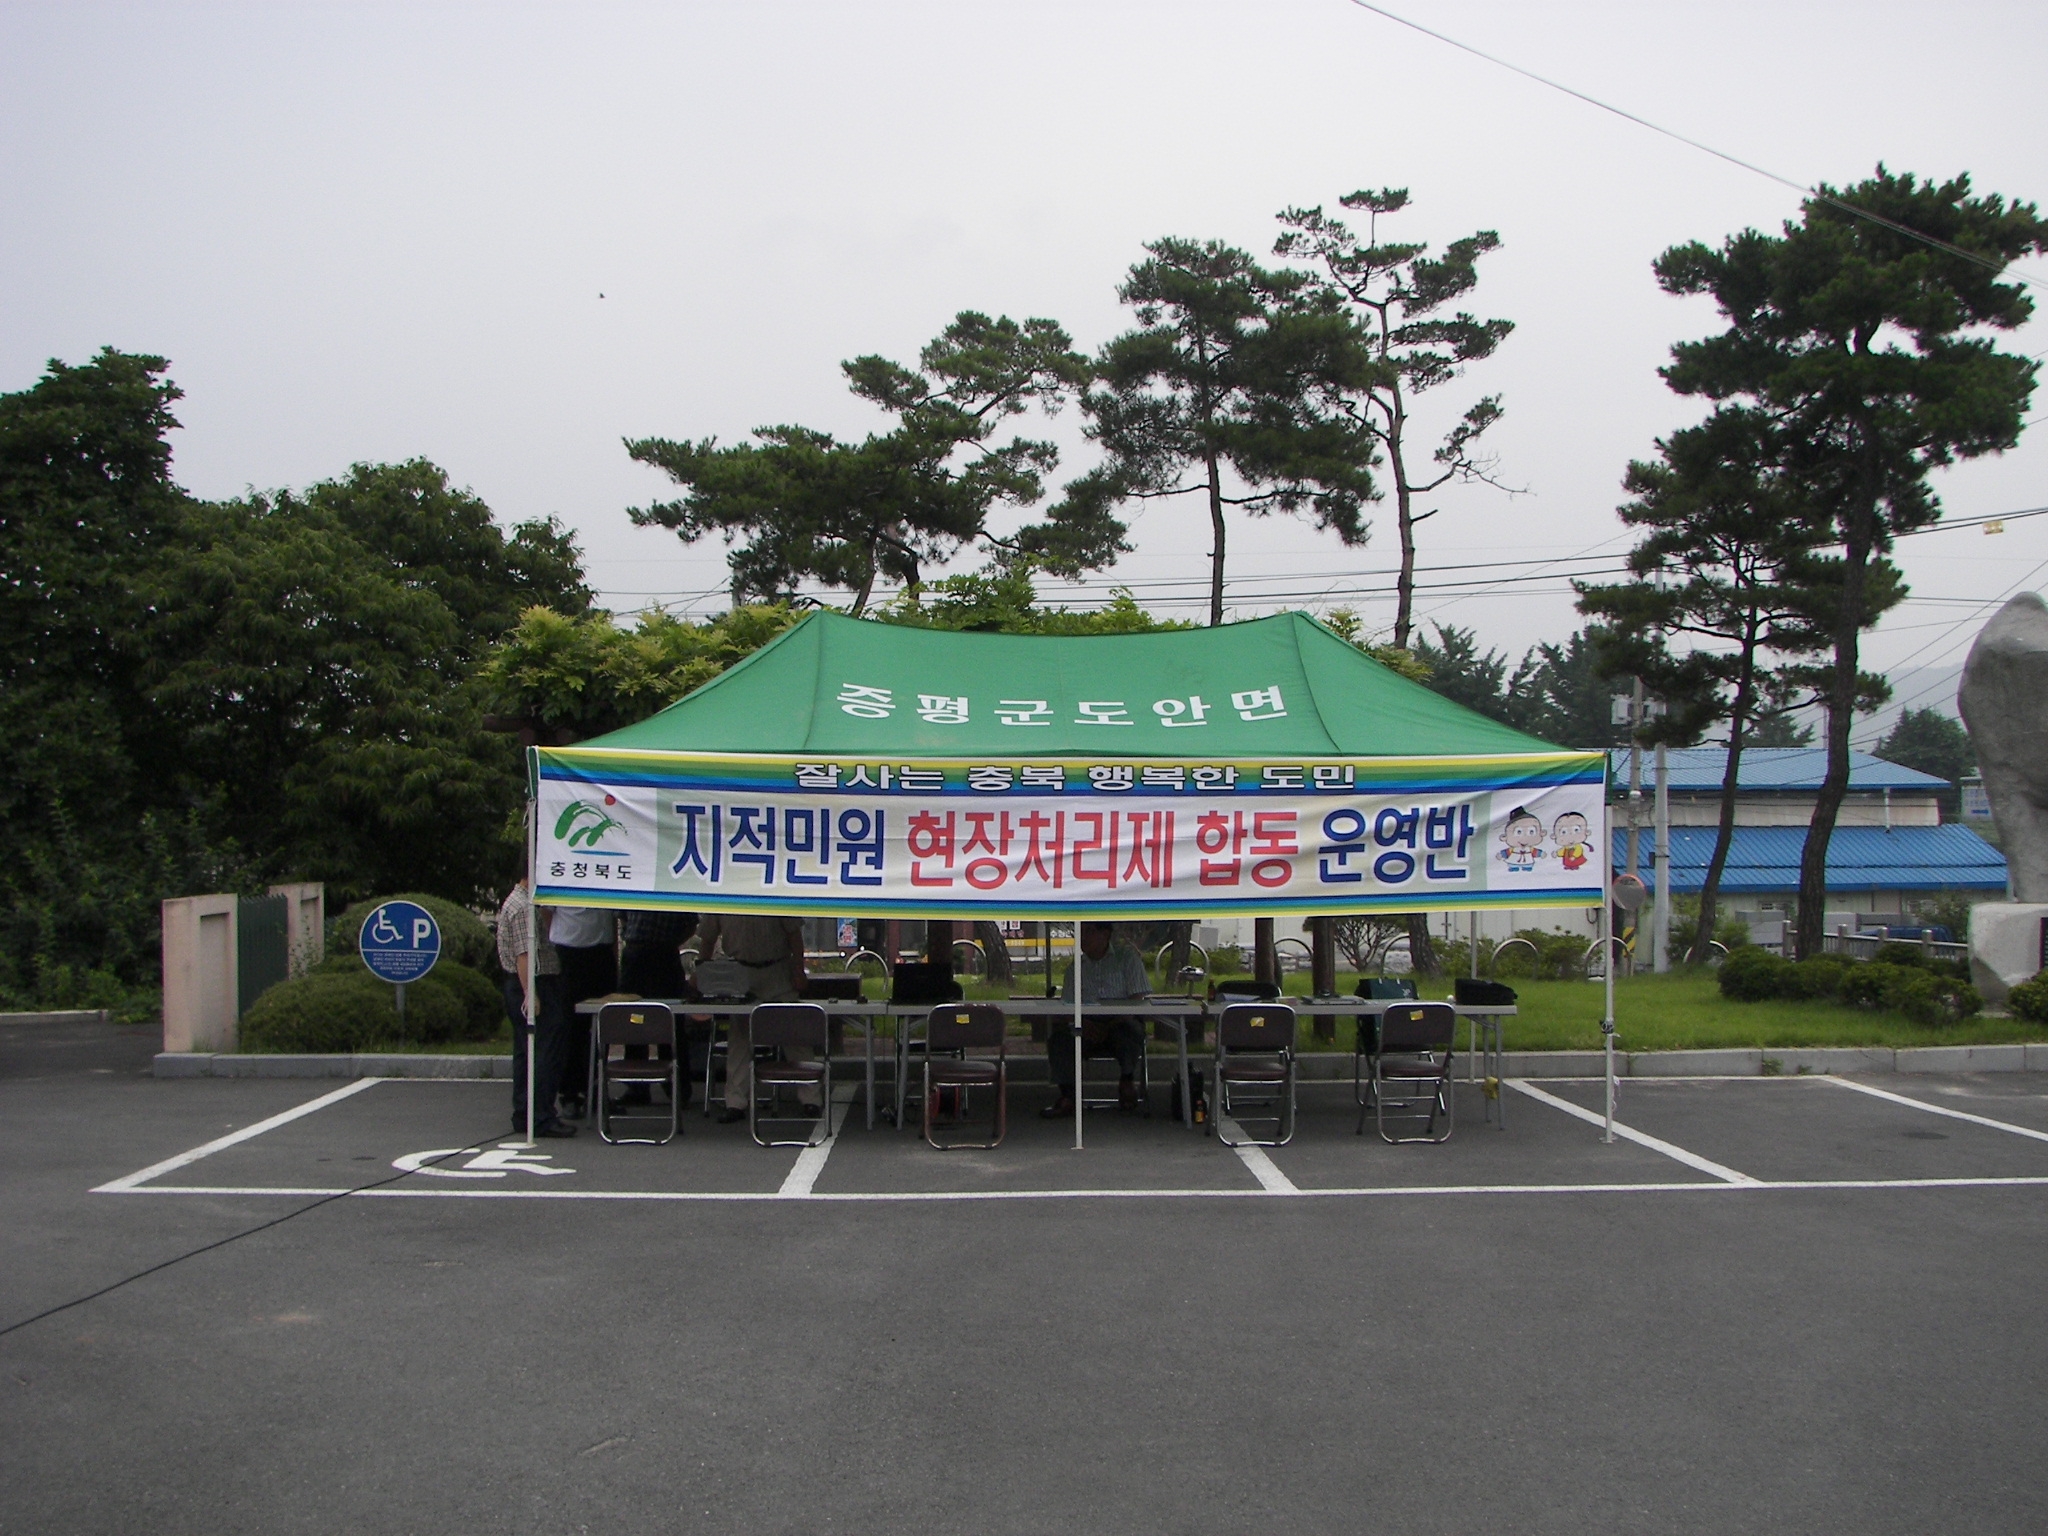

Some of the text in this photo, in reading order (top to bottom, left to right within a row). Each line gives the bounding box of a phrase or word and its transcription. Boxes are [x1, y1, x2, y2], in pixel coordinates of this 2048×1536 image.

[795, 763, 1355, 791] 잘사는 충북 행복한 도민
[673, 804, 1475, 890] 지적민원 현장처리제 합동 운영반
[550, 861, 632, 880] 충청북도
[413, 918, 431, 949] P
